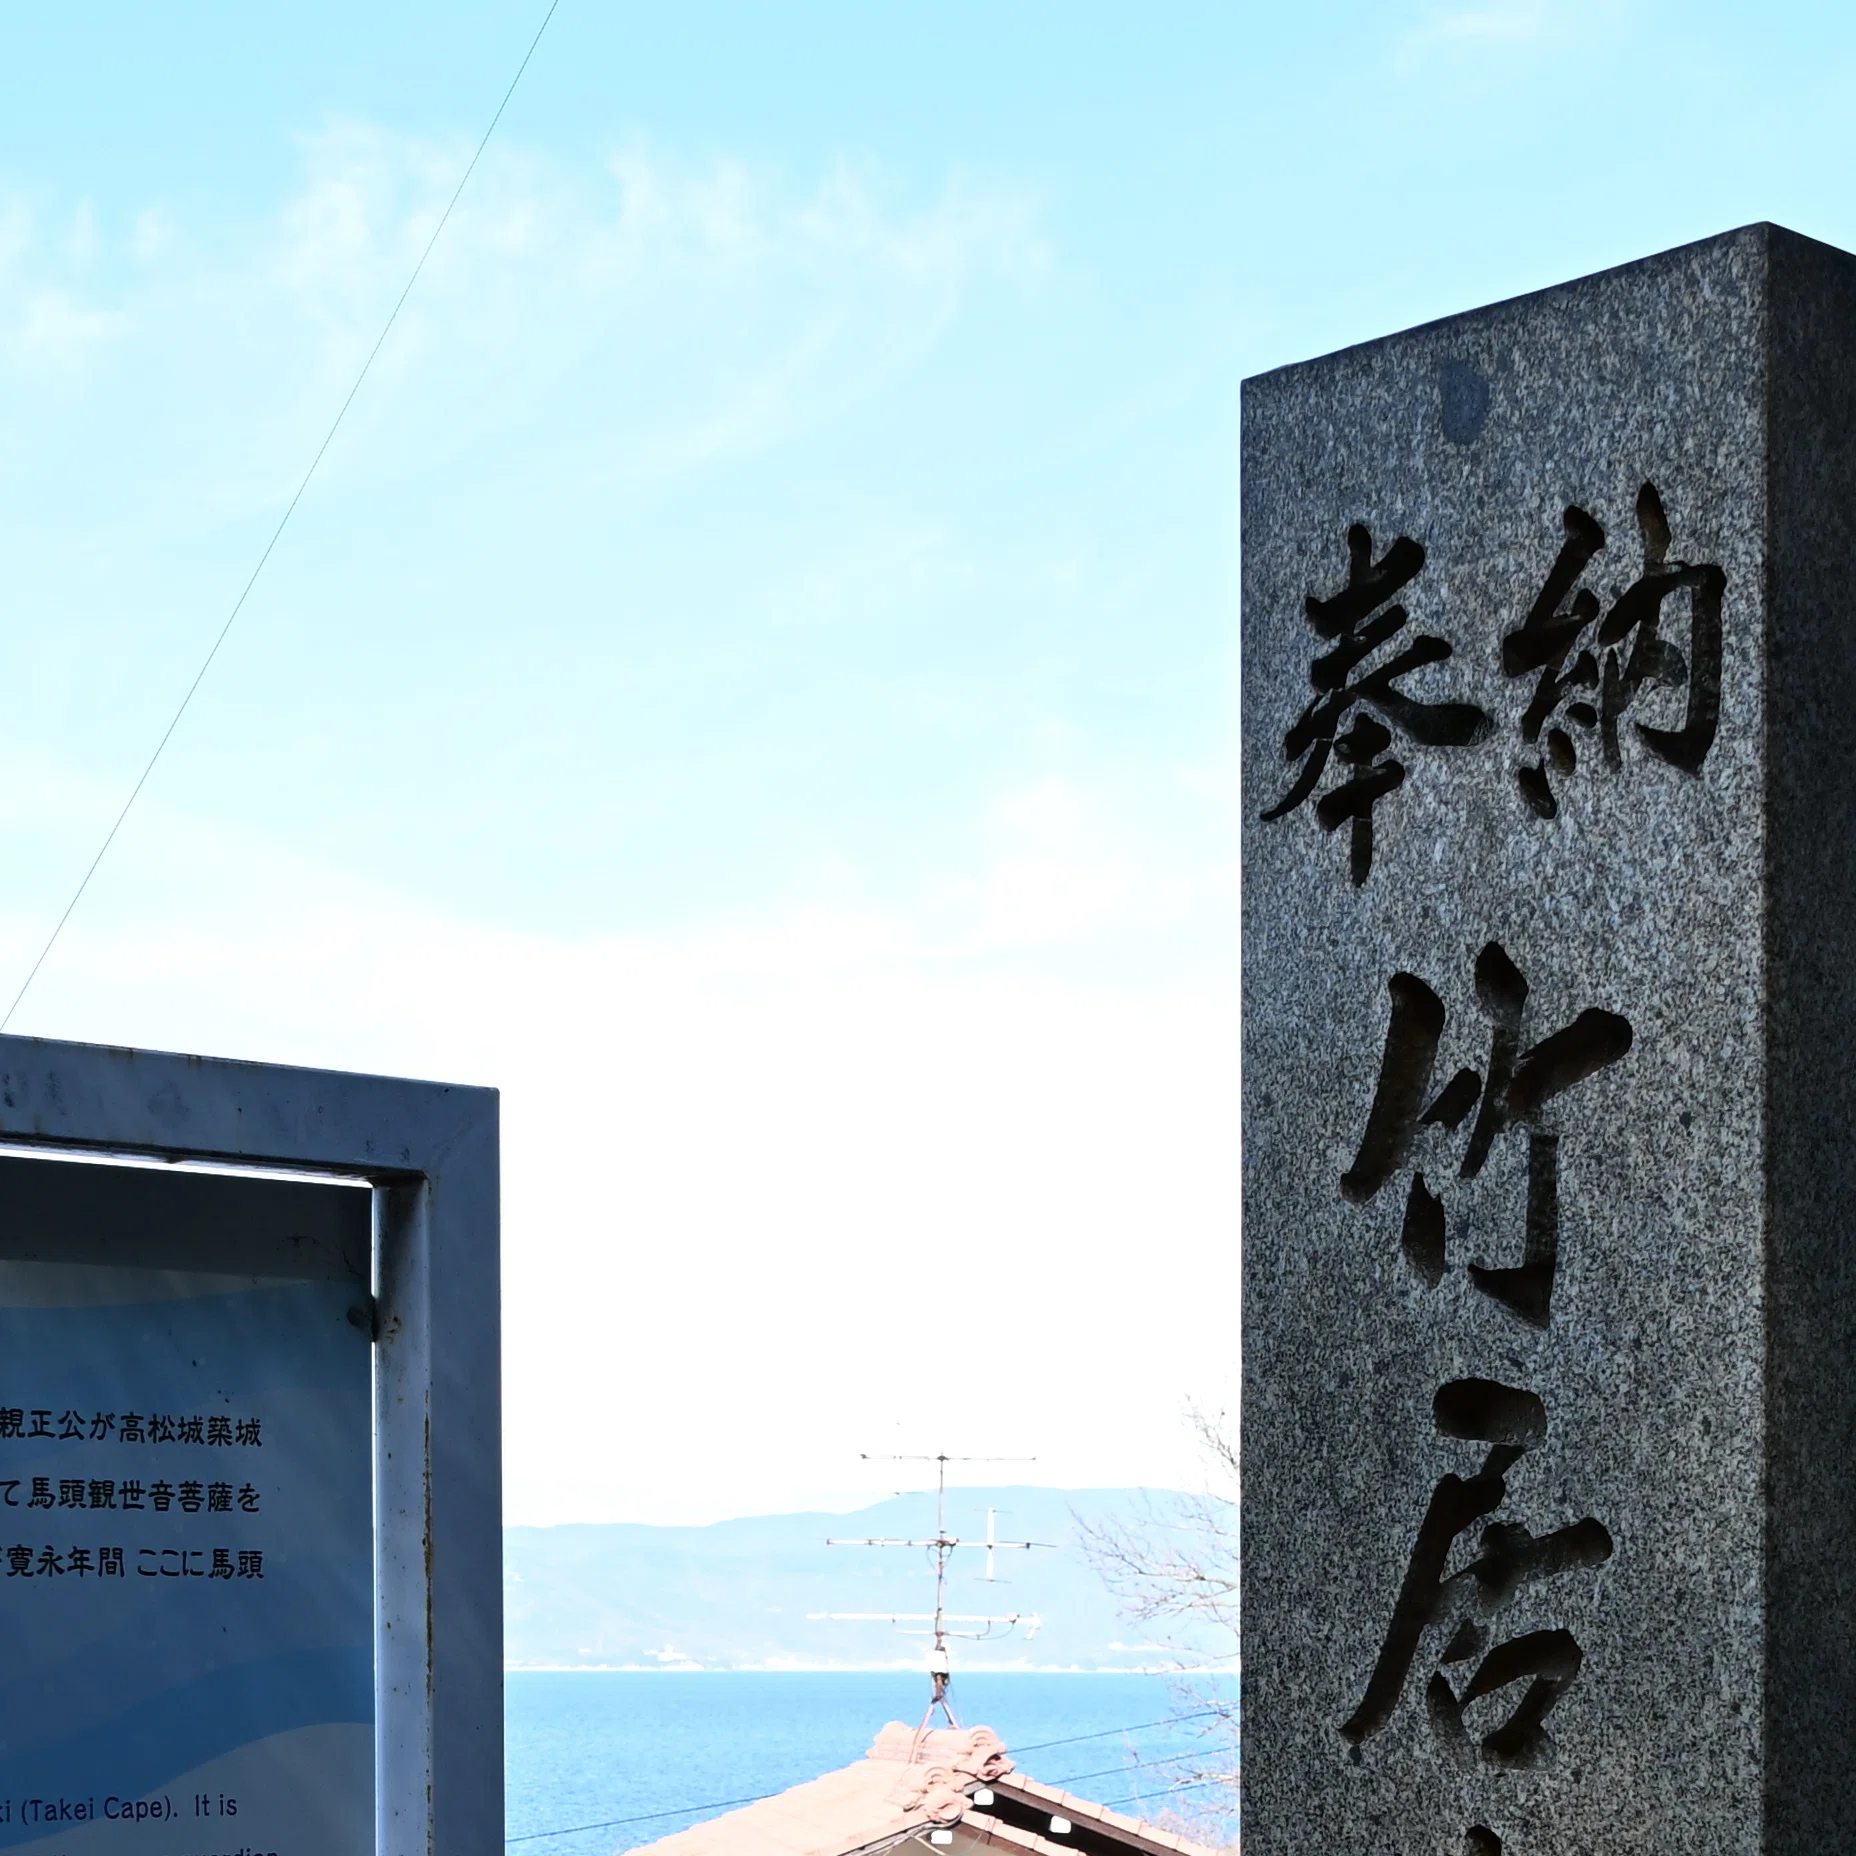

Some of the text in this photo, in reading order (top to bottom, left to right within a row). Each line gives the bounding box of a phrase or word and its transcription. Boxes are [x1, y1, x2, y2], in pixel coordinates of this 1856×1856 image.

[21, 1796, 95, 1827] (Takei
[103, 1794, 179, 1823] Cape).
[194, 1793, 211, 1818] It
[219, 1793, 238, 1817] is
